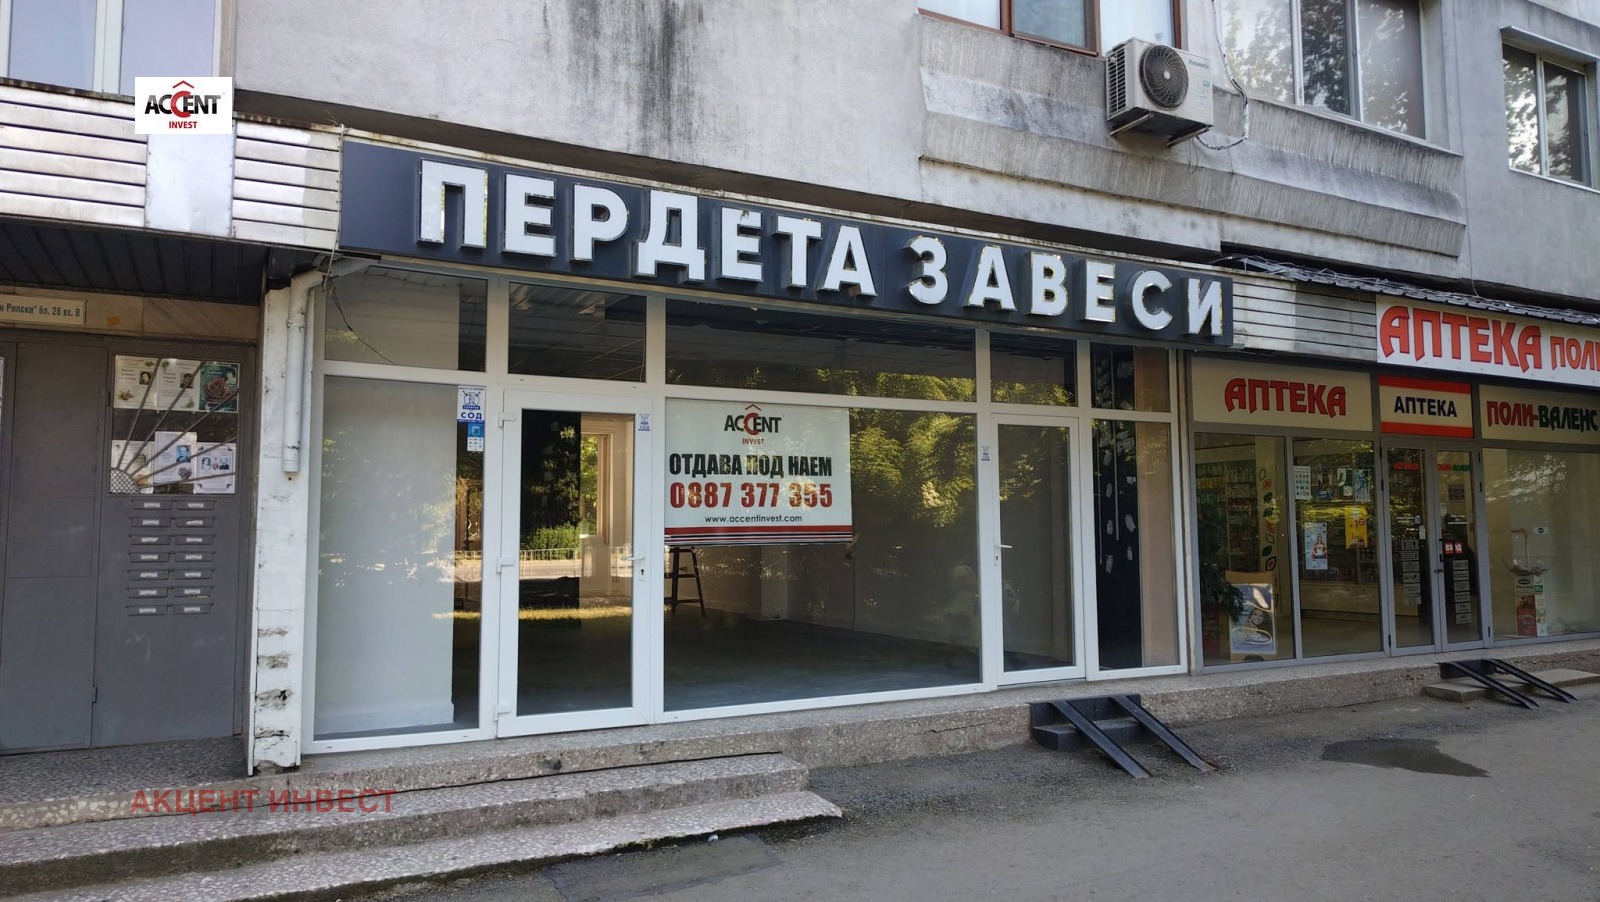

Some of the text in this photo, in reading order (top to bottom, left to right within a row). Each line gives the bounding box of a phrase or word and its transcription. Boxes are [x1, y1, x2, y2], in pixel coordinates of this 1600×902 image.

[418, 157, 1224, 337] ПЕРДЕТА ЗАВЕСИ
[39, 306, 50, 315] бл.
[52, 306, 61, 316] 28
[1380, 305, 1543, 373] АПТЕКА
[1224, 377, 1346, 419] АПТЕКА
[1394, 395, 1458, 418] АПТЕКА
[461, 411, 482, 420] СОД
[724, 412, 782, 436] ACCENT
[669, 452, 832, 479] ОТДАВА ПОД НАЕМ
[670, 481, 833, 509] 0887 377 355
[705, 514, 803, 523] www.accentinvest.com
